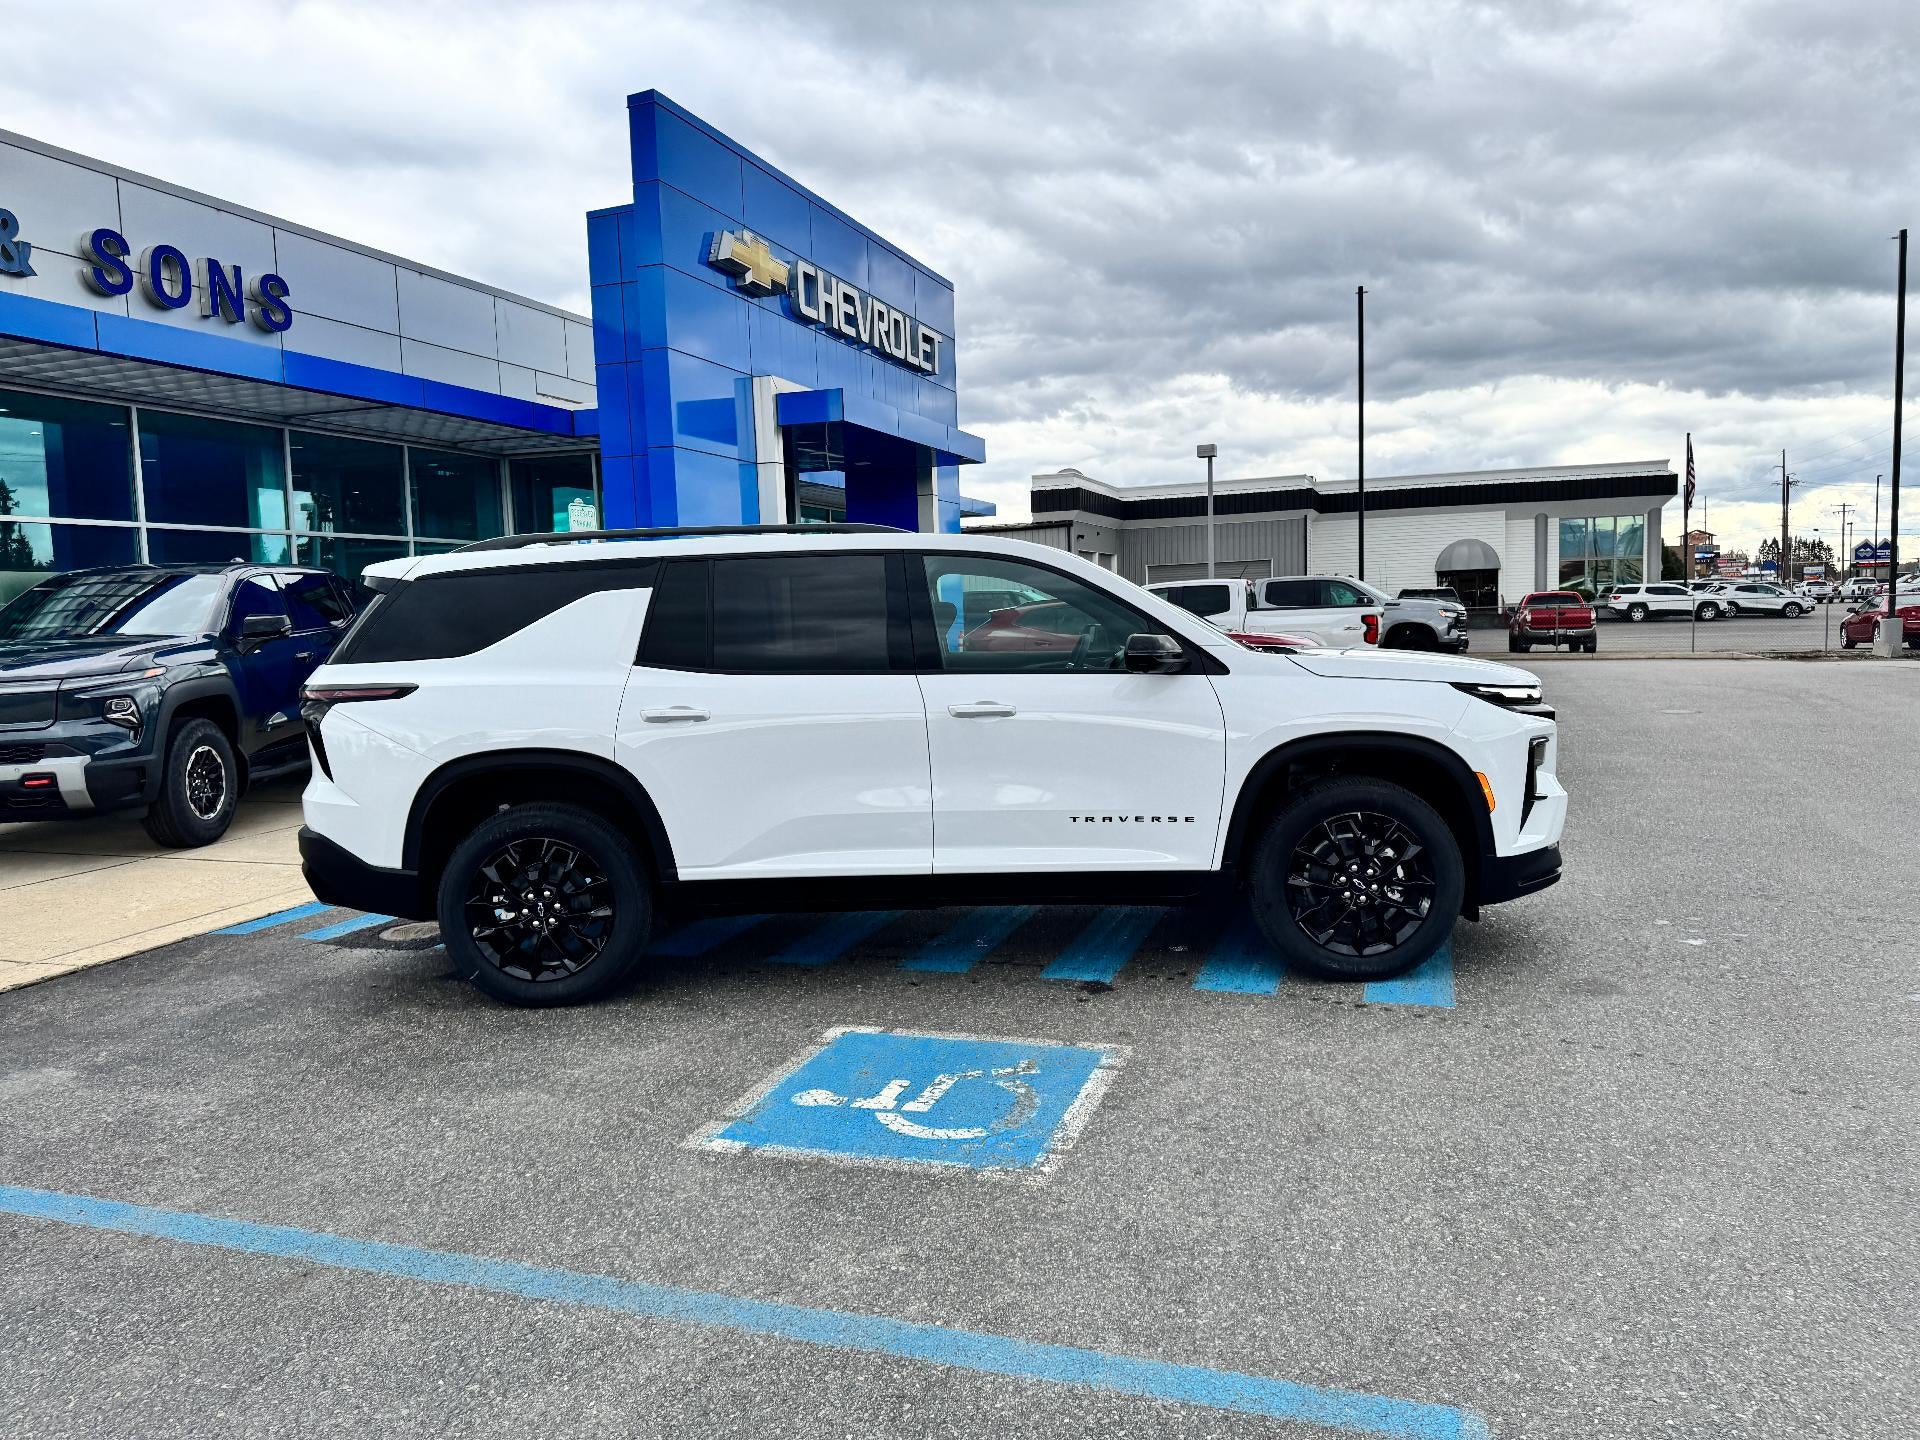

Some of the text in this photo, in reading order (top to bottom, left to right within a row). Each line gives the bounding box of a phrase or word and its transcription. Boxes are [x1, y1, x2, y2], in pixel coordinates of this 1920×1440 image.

[81, 228, 293, 333] SONS
[795, 259, 943, 376] CHEVROLET
[1069, 815, 1195, 823] TRAVERSE
